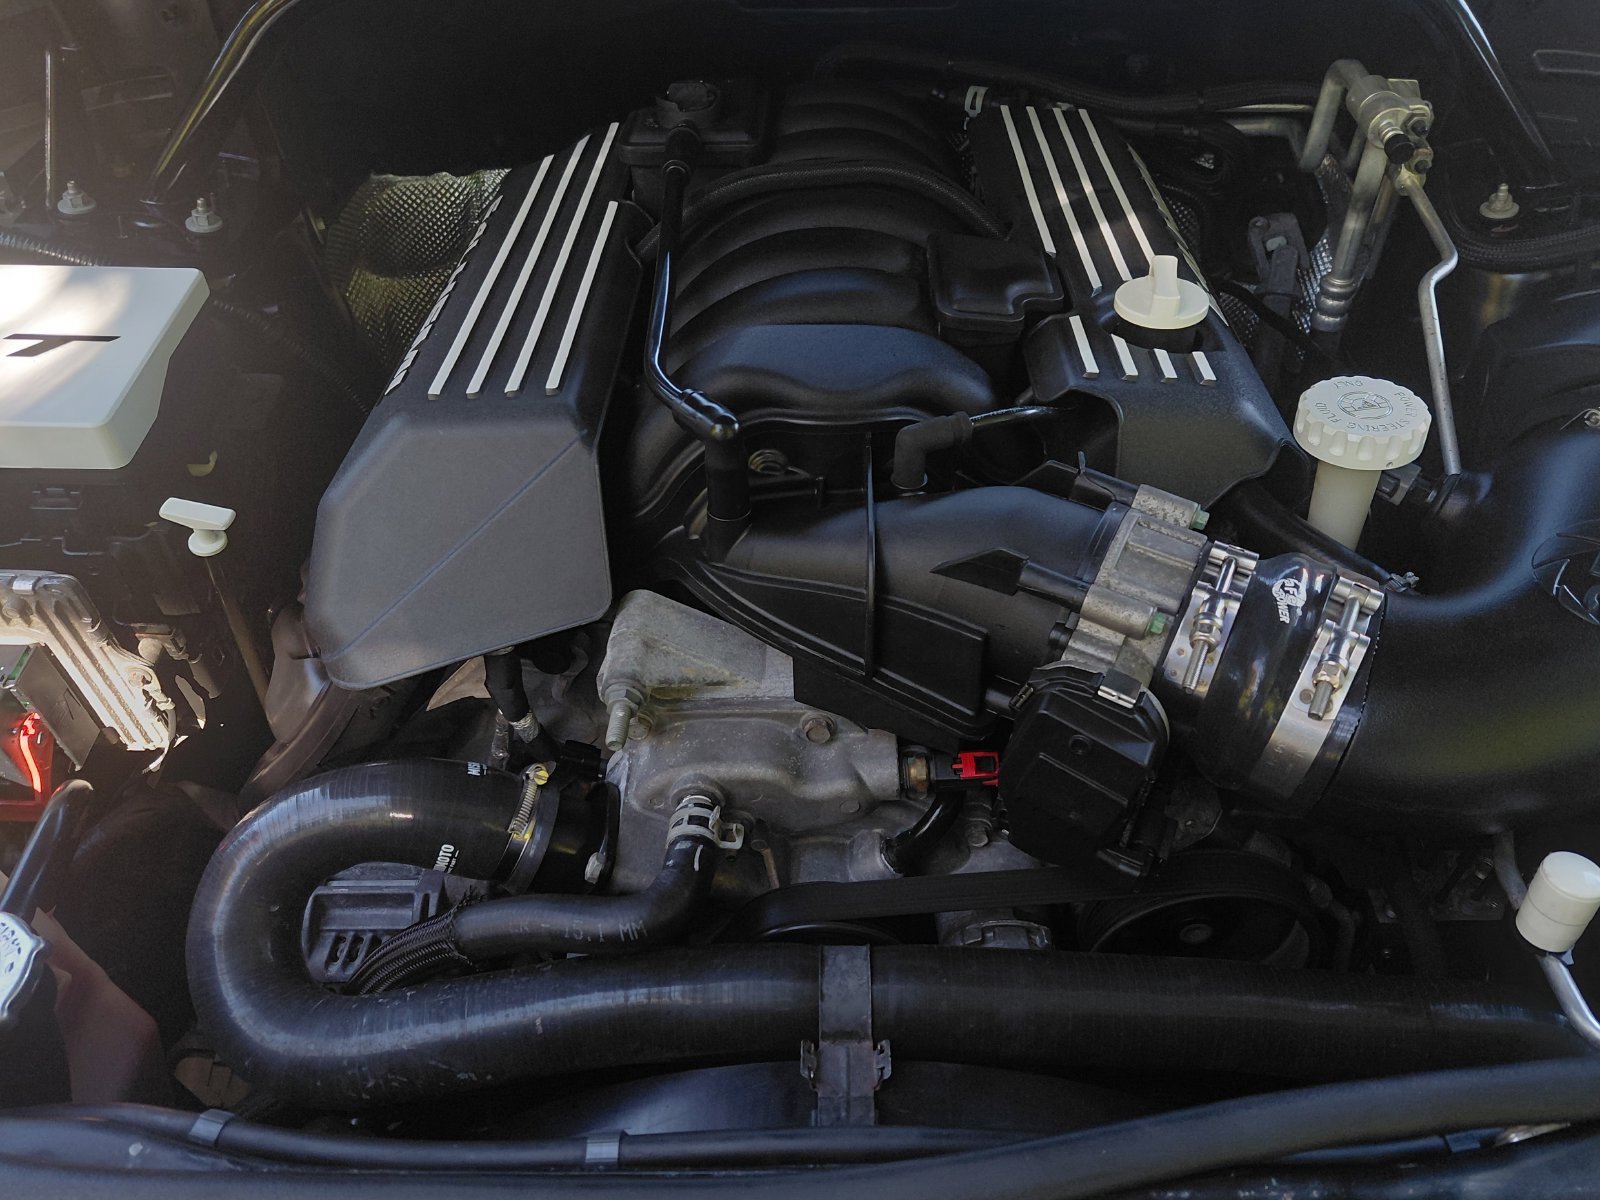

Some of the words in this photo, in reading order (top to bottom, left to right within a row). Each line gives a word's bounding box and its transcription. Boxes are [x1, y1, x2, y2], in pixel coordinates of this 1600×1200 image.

[1333, 380, 1364, 389] ONLY
[1315, 402, 1342, 423] FLUID
[1394, 391, 1418, 418] POWER
[1346, 418, 1410, 433] STEERING
[618, 919, 649, 942] MM
